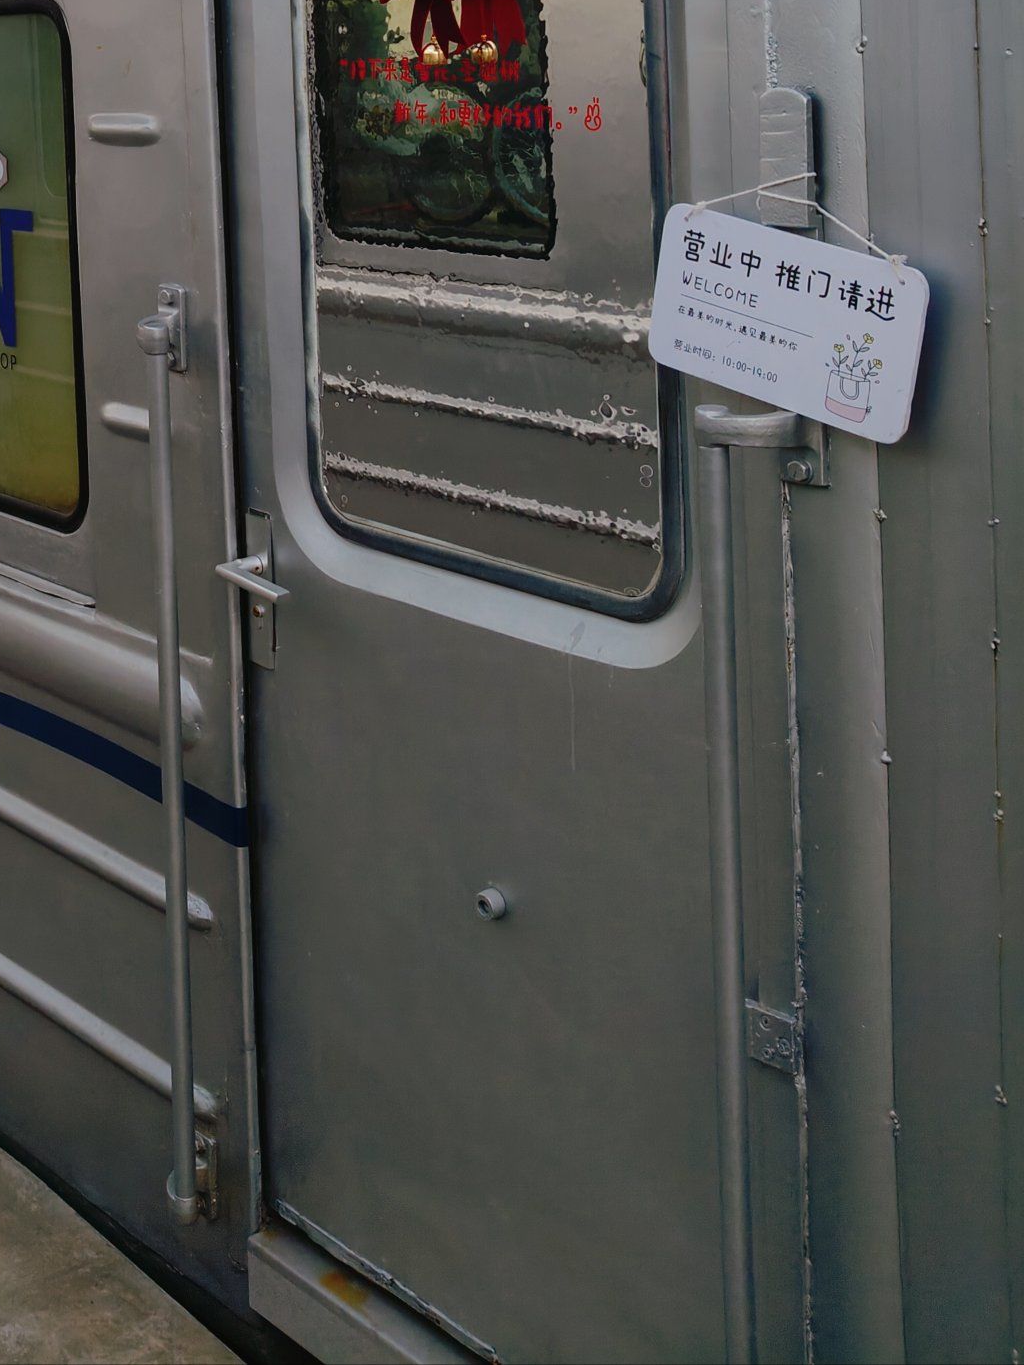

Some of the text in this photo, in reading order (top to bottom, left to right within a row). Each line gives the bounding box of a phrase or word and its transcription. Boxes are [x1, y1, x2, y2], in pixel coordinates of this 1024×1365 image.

[681, 271, 760, 309] WELCOME
[682, 229, 896, 322] 营业中 推门请进
[721, 355, 779, 383] 10:00-19:00
